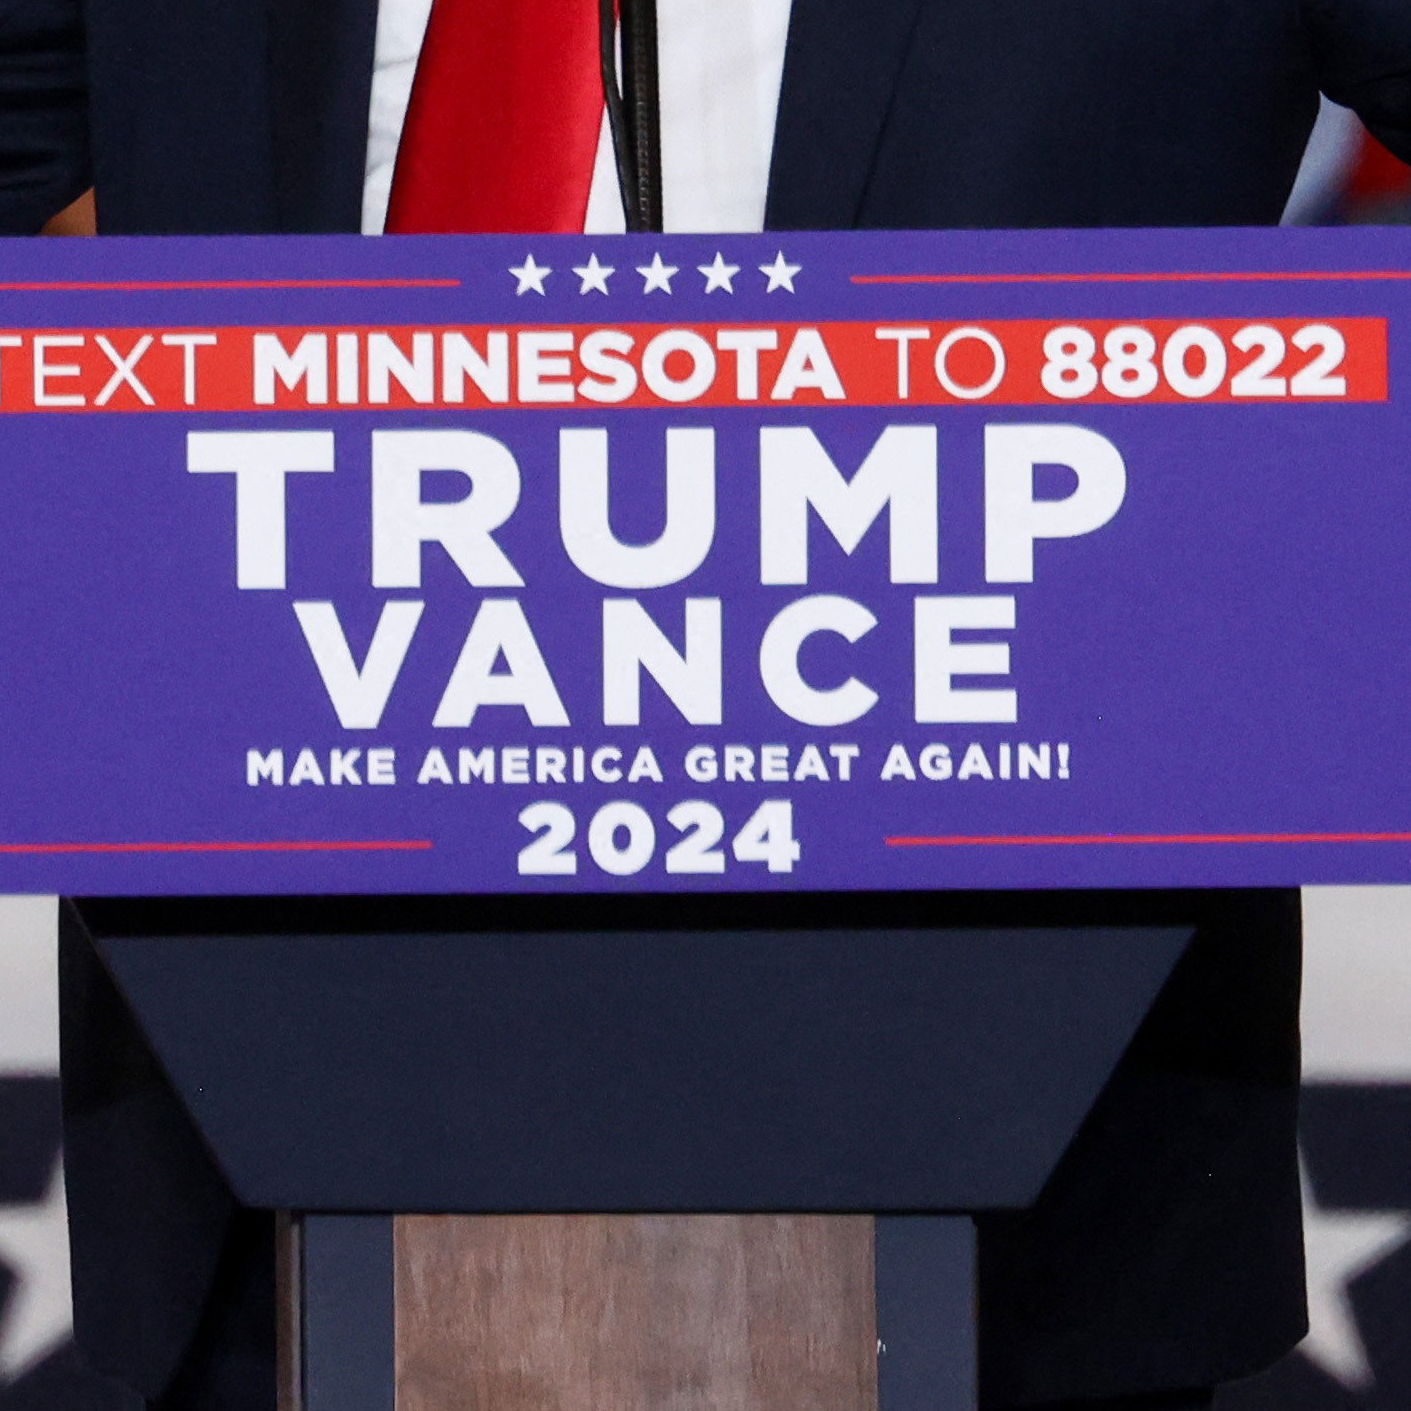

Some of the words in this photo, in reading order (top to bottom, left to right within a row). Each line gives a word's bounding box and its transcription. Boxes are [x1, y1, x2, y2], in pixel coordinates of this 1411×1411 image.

[252, 327, 847, 406] MINNESOTA
[874, 325, 1007, 401] TO
[1039, 322, 1348, 400] 88022
[185, 422, 1128, 591] TRUMP
[291, 593, 1019, 731] VANCE
[245, 747, 397, 787] MAKE
[416, 744, 665, 785] AMERICA
[683, 743, 861, 784] GREAT
[879, 742, 1071, 782] AGAIN!
[516, 799, 802, 877] 2024
